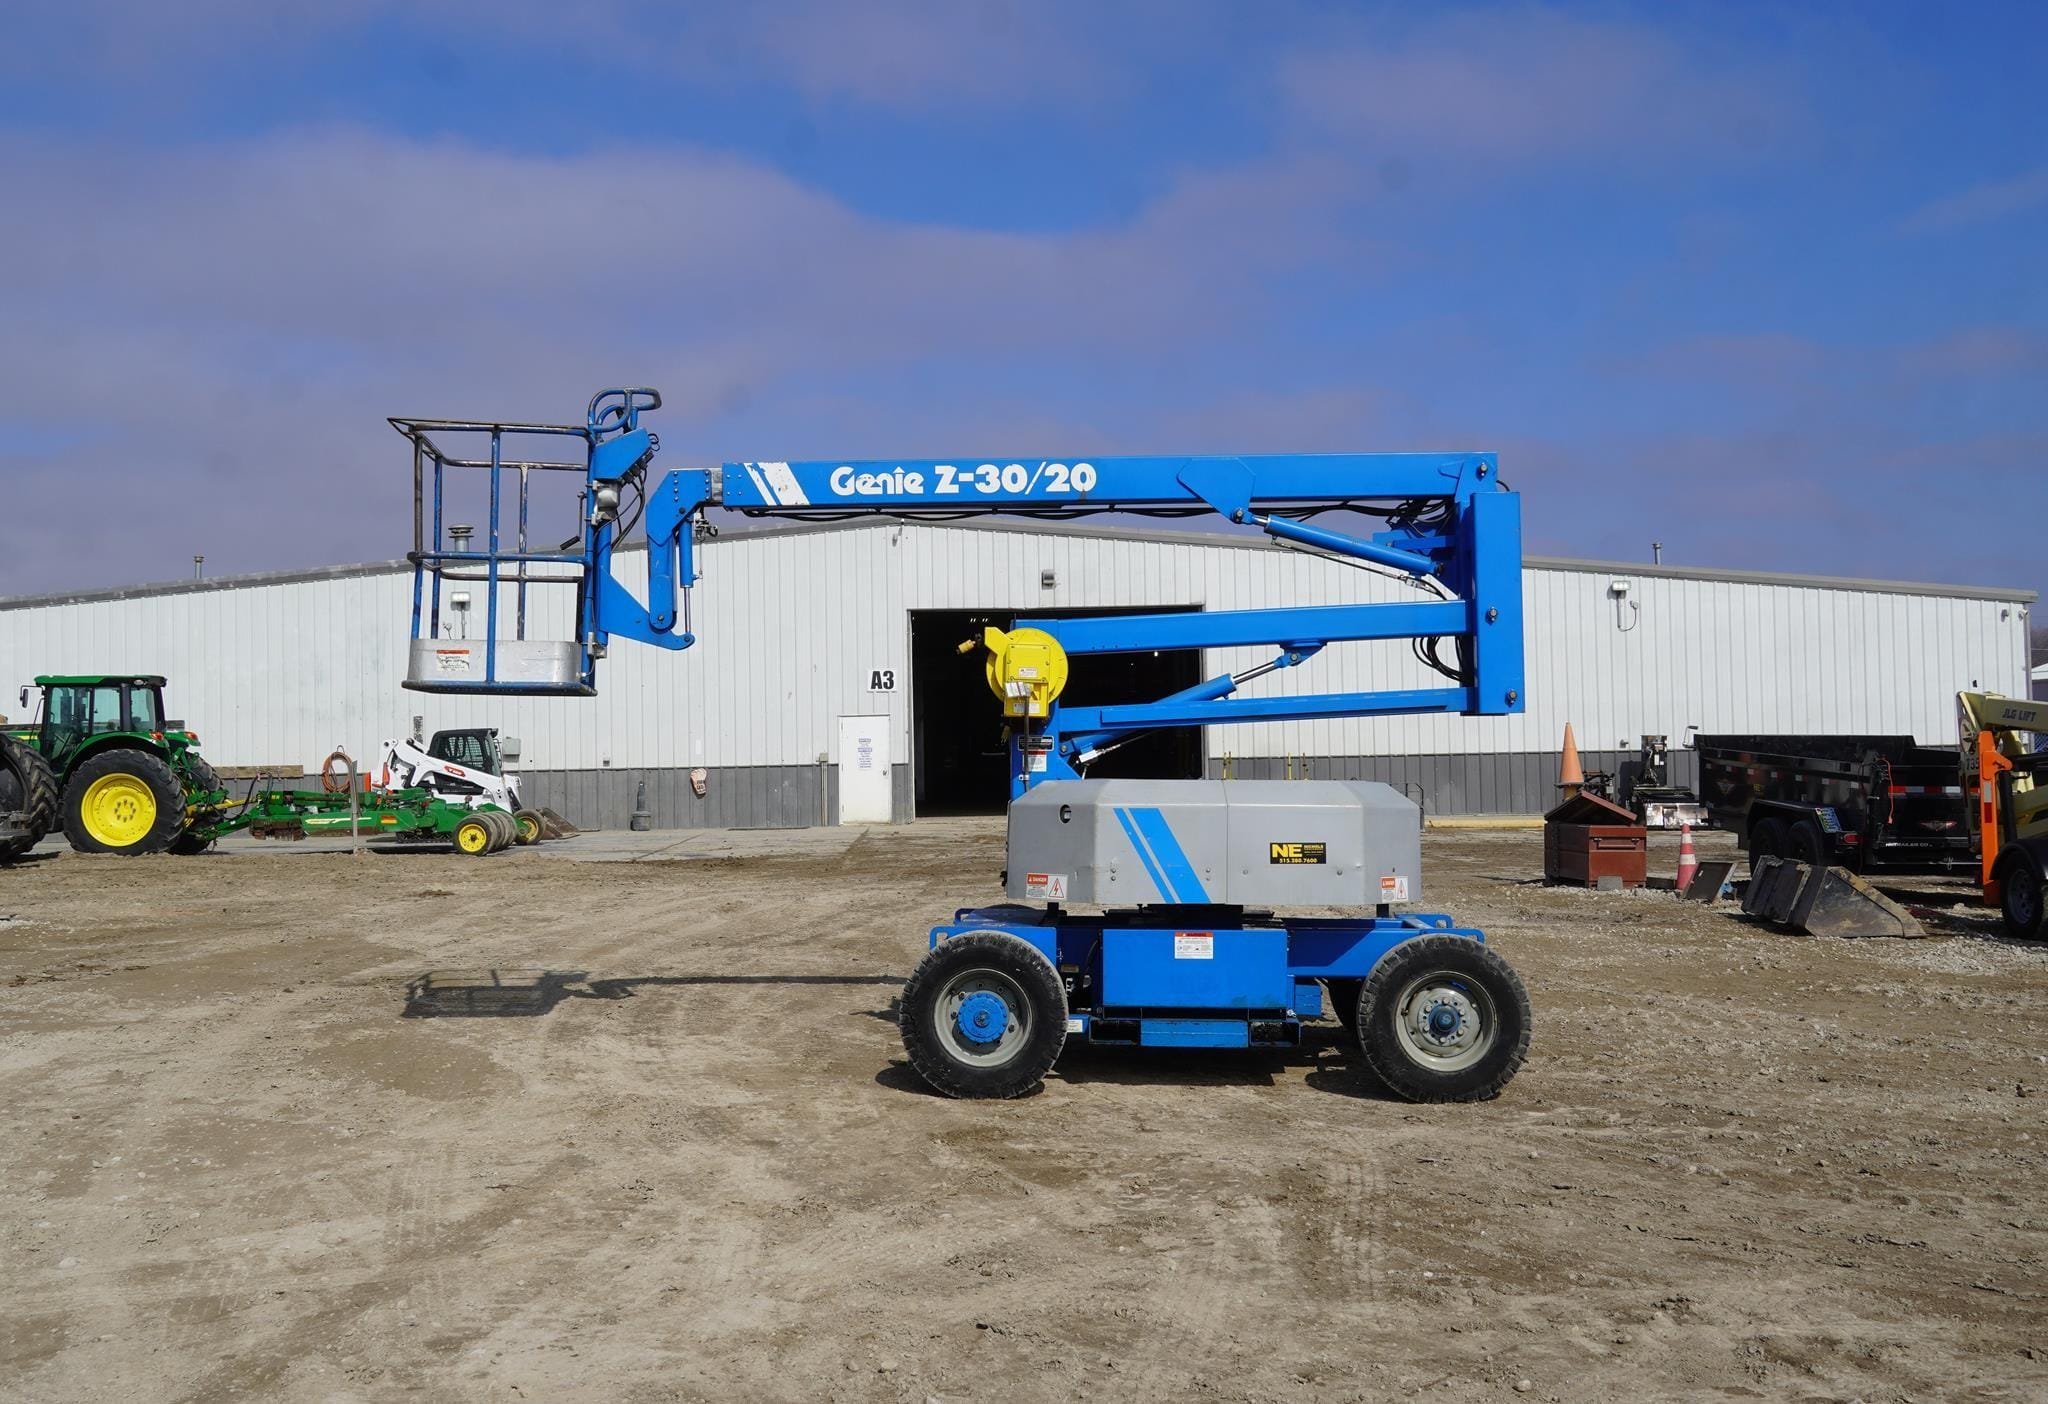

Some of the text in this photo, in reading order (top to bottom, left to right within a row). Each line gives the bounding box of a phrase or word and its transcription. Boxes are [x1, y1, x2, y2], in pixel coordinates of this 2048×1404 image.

[830, 461, 1097, 496] Genie Z-30/20
[871, 670, 894, 690] A3
[2003, 709, 2037, 722] JLG LIFT
[1272, 843, 1302, 858] NE
